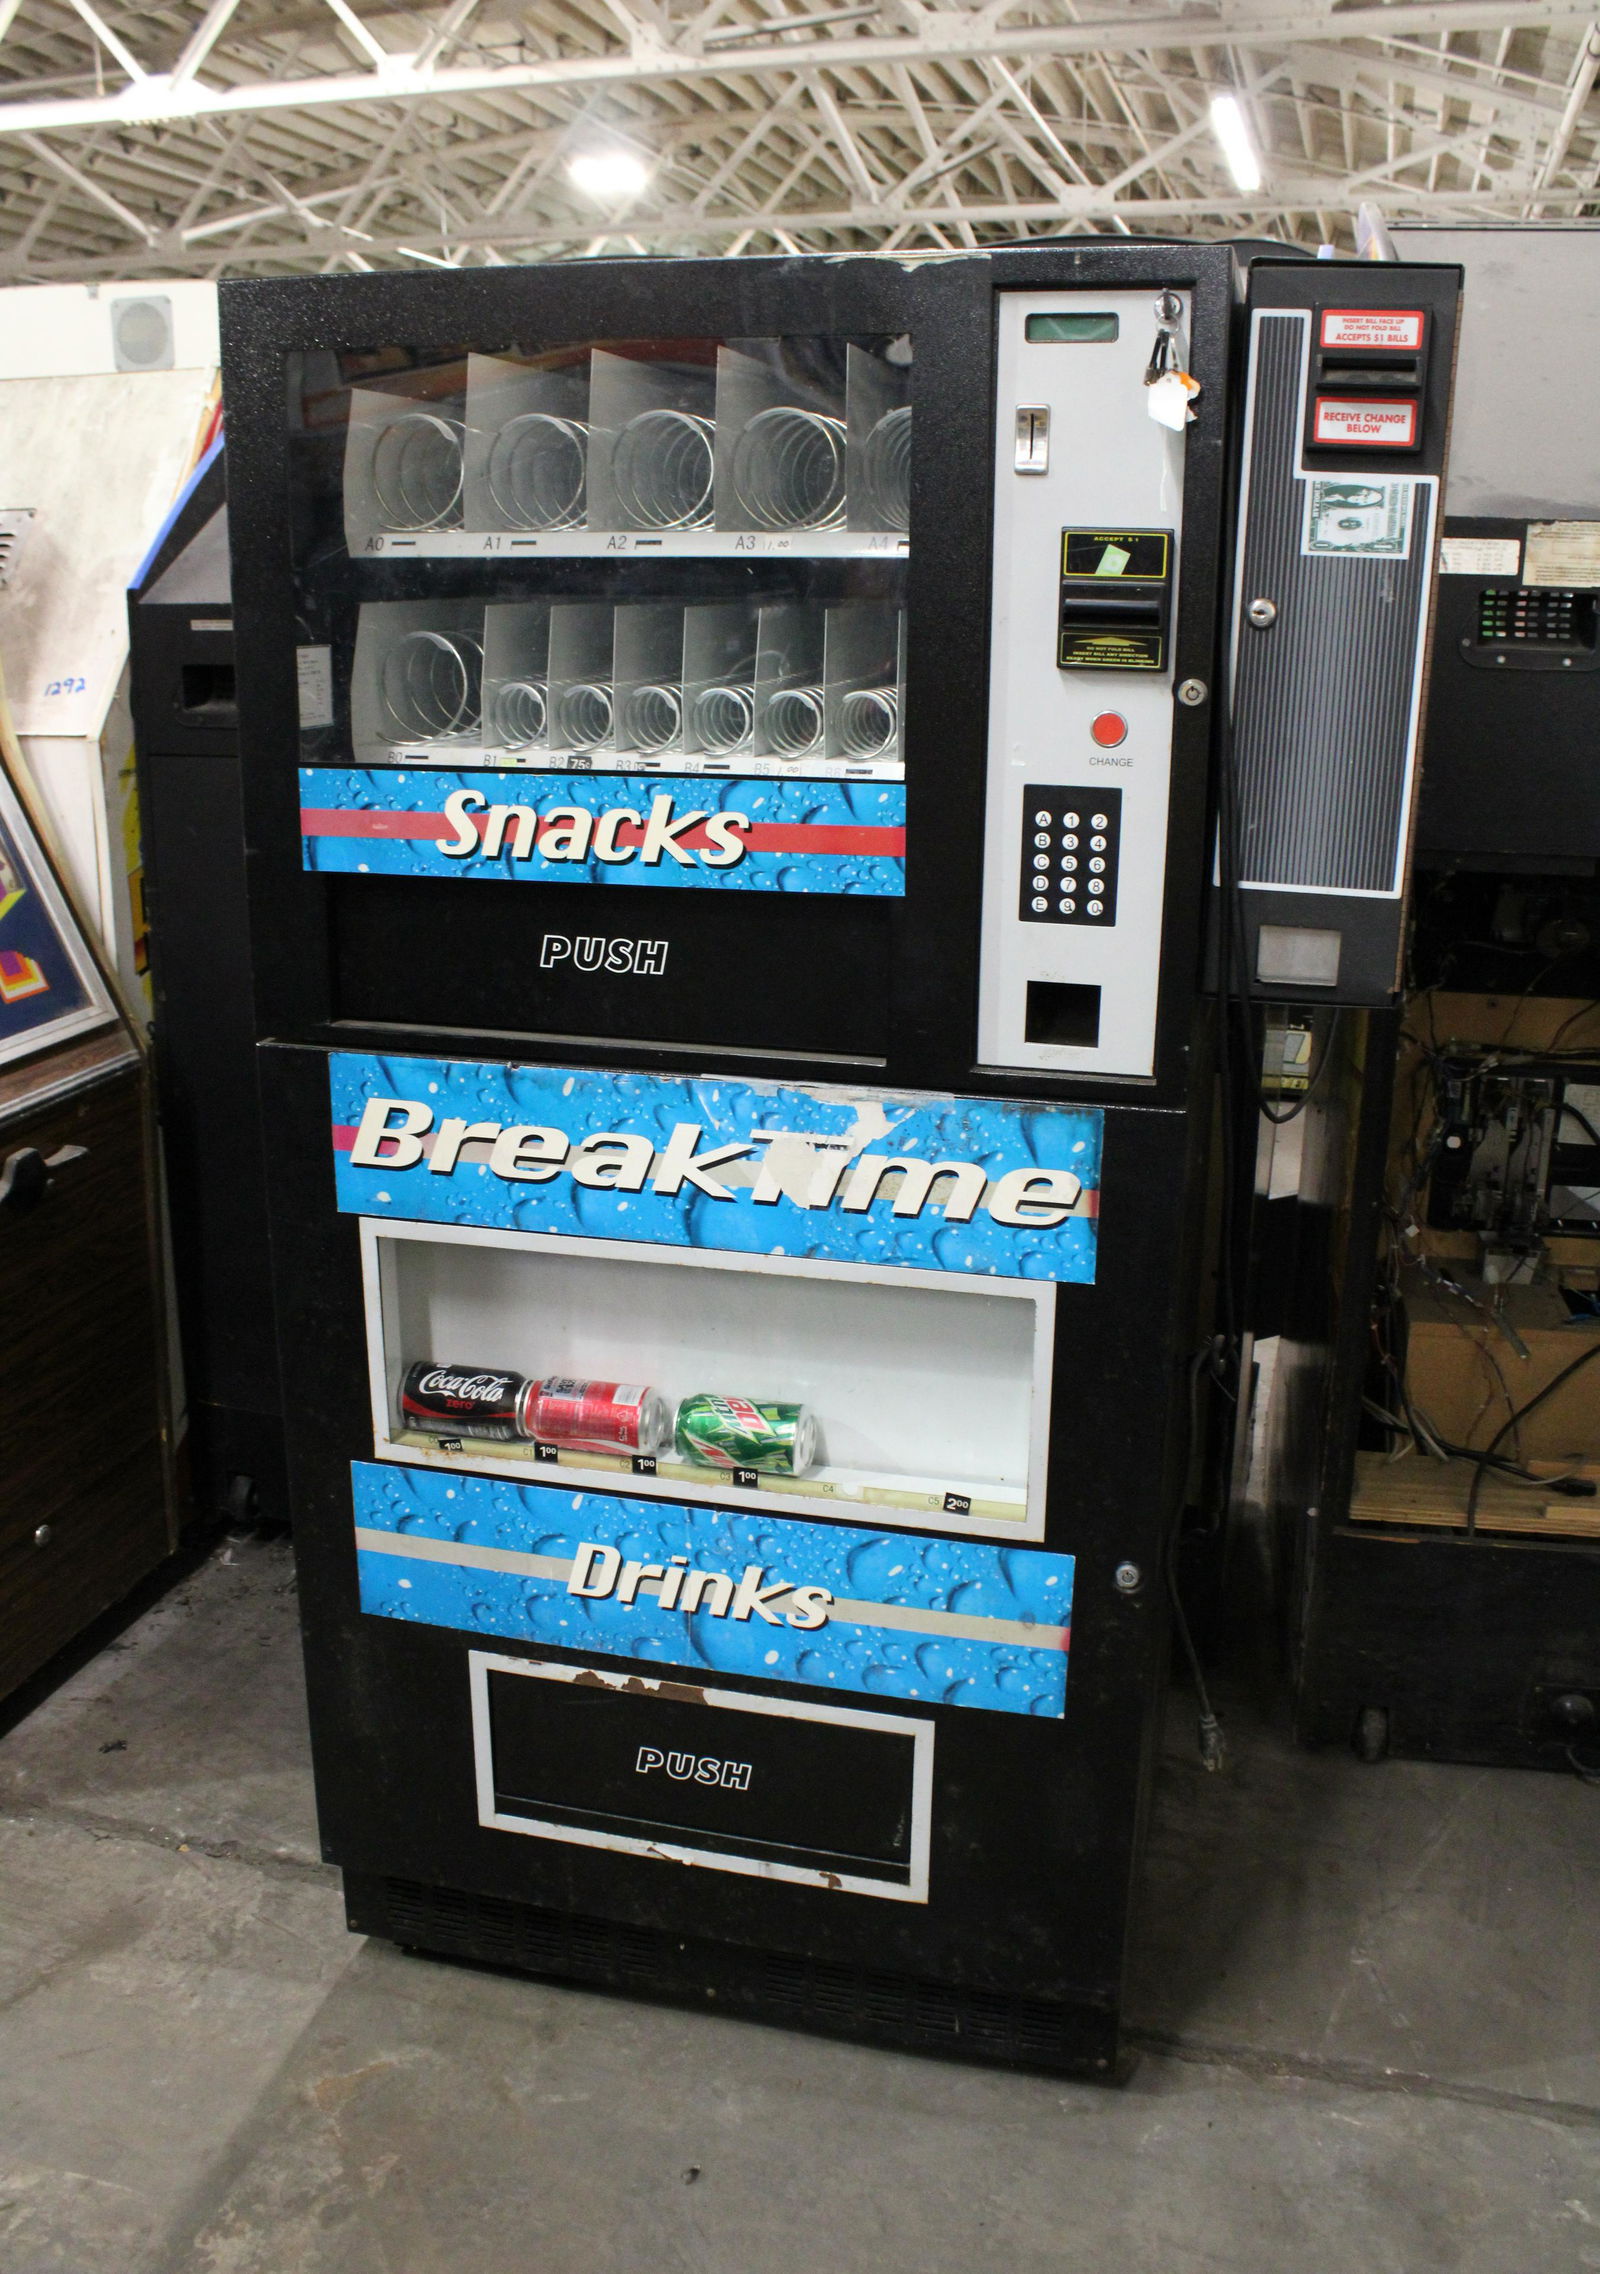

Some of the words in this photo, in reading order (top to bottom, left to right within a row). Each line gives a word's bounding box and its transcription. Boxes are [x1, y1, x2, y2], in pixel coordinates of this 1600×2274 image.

[1336, 333, 1370, 341] ACCEPTS
[1374, 334, 1384, 342] $1
[1387, 334, 1408, 342] BILLS
[1324, 412, 1361, 422] RECEIVE
[1364, 413, 1406, 424] CHANGE
[1346, 424, 1382, 433] BELOW
[365, 537, 384, 552] A0
[483, 536, 502, 550] A1
[607, 536, 627, 550] A2
[735, 536, 756, 550] A3
[868, 536, 888, 549] A4
[45, 678, 86, 697] 1292
[388, 752, 402, 764] B0
[484, 754, 497, 766] B1
[549, 756, 564, 768] B2
[1088, 757, 1134, 768] CHANGE
[616, 760, 631, 770] B3
[684, 762, 700, 772] B4
[754, 762, 770, 774] B5
[1038, 814, 1049, 824] A
[1096, 817, 1103, 827] 2
[435, 789, 751, 868] Snacks
[1038, 835, 1047, 846] B
[1067, 837, 1074, 847] 3
[1094, 838, 1102, 849] 4
[1038, 857, 1046, 867] C
[1066, 858, 1073, 869] 5
[1093, 860, 1101, 870] 6
[1036, 878, 1046, 888] D
[1065, 880, 1073, 890] 7
[1092, 881, 1100, 892] 8
[1036, 900, 1044, 910] E
[1064, 901, 1071, 911] 9
[1092, 903, 1099, 913] 0
[540, 934, 669, 975] PUSH
[418, 1369, 514, 1402] Coca-Cola
[446, 1399, 476, 1410] zero
[620, 1460, 630, 1468] C2
[720, 1472, 731, 1481] C3
[823, 1485, 834, 1493] C4
[928, 1496, 940, 1506] C5
[566, 1542, 834, 1629] Drinks
[636, 1746, 752, 1790] PUSH
